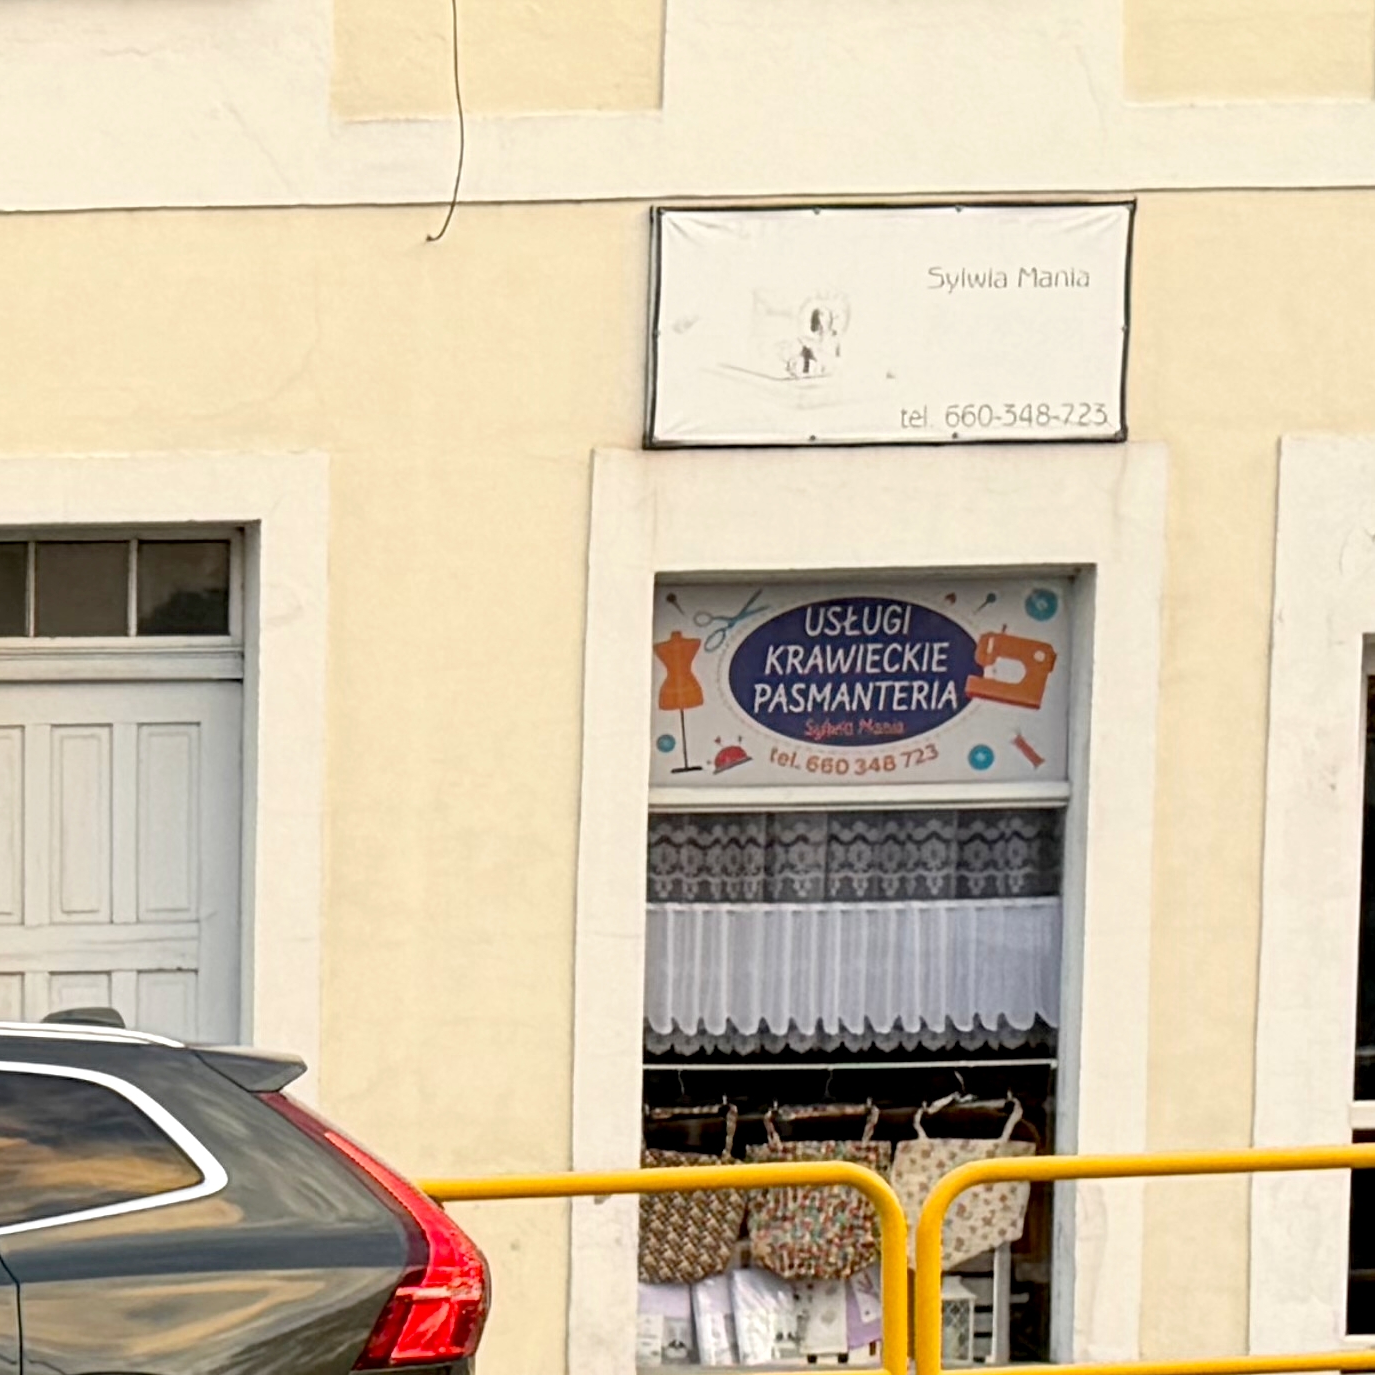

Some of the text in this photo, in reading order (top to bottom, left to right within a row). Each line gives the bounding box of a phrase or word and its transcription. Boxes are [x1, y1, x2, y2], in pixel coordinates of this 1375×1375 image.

[926, 265, 1090, 294] Sylwia Mania
[945, 402, 1108, 428] 660-348-723
[804, 604, 912, 637] USŁUGI
[764, 641, 950, 676] KRAWIECKIE
[753, 680, 958, 714] PASMANTERIA
[806, 755, 850, 775] 660
[854, 754, 897, 775] 348
[900, 743, 940, 768] 723
